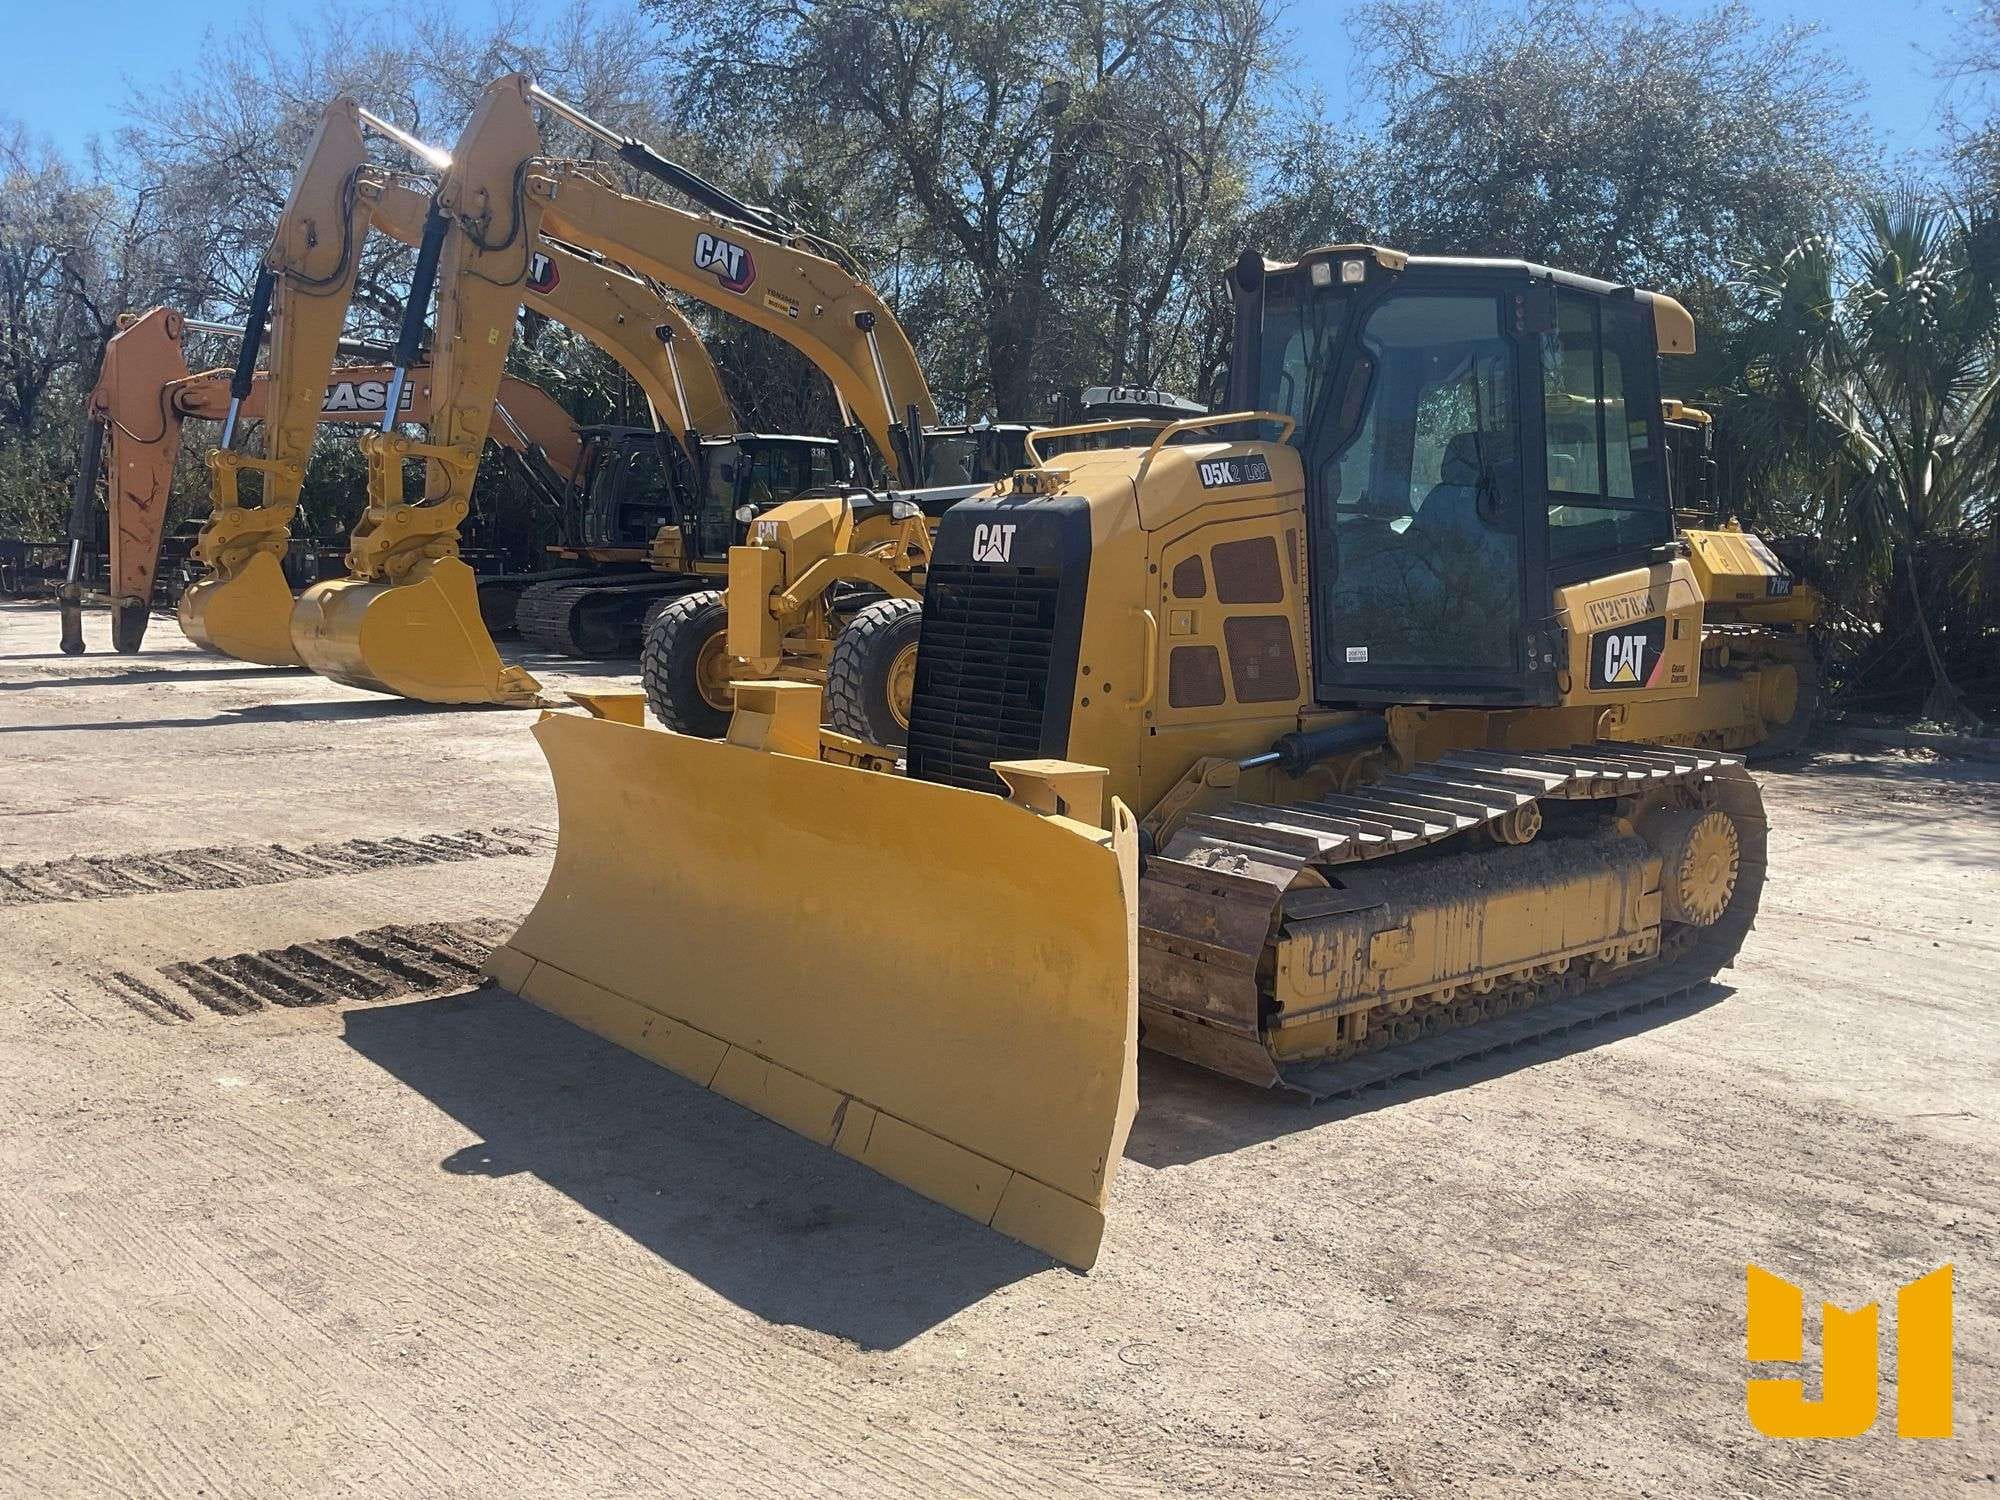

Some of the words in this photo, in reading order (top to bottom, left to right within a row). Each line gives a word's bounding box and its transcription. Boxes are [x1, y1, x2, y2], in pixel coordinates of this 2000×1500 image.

[695, 233, 744, 281] CAT
[322, 381, 414, 411] ASE
[757, 521, 779, 542] CAT
[973, 523, 1017, 563] CAT
[1604, 635, 1647, 683] CAT
